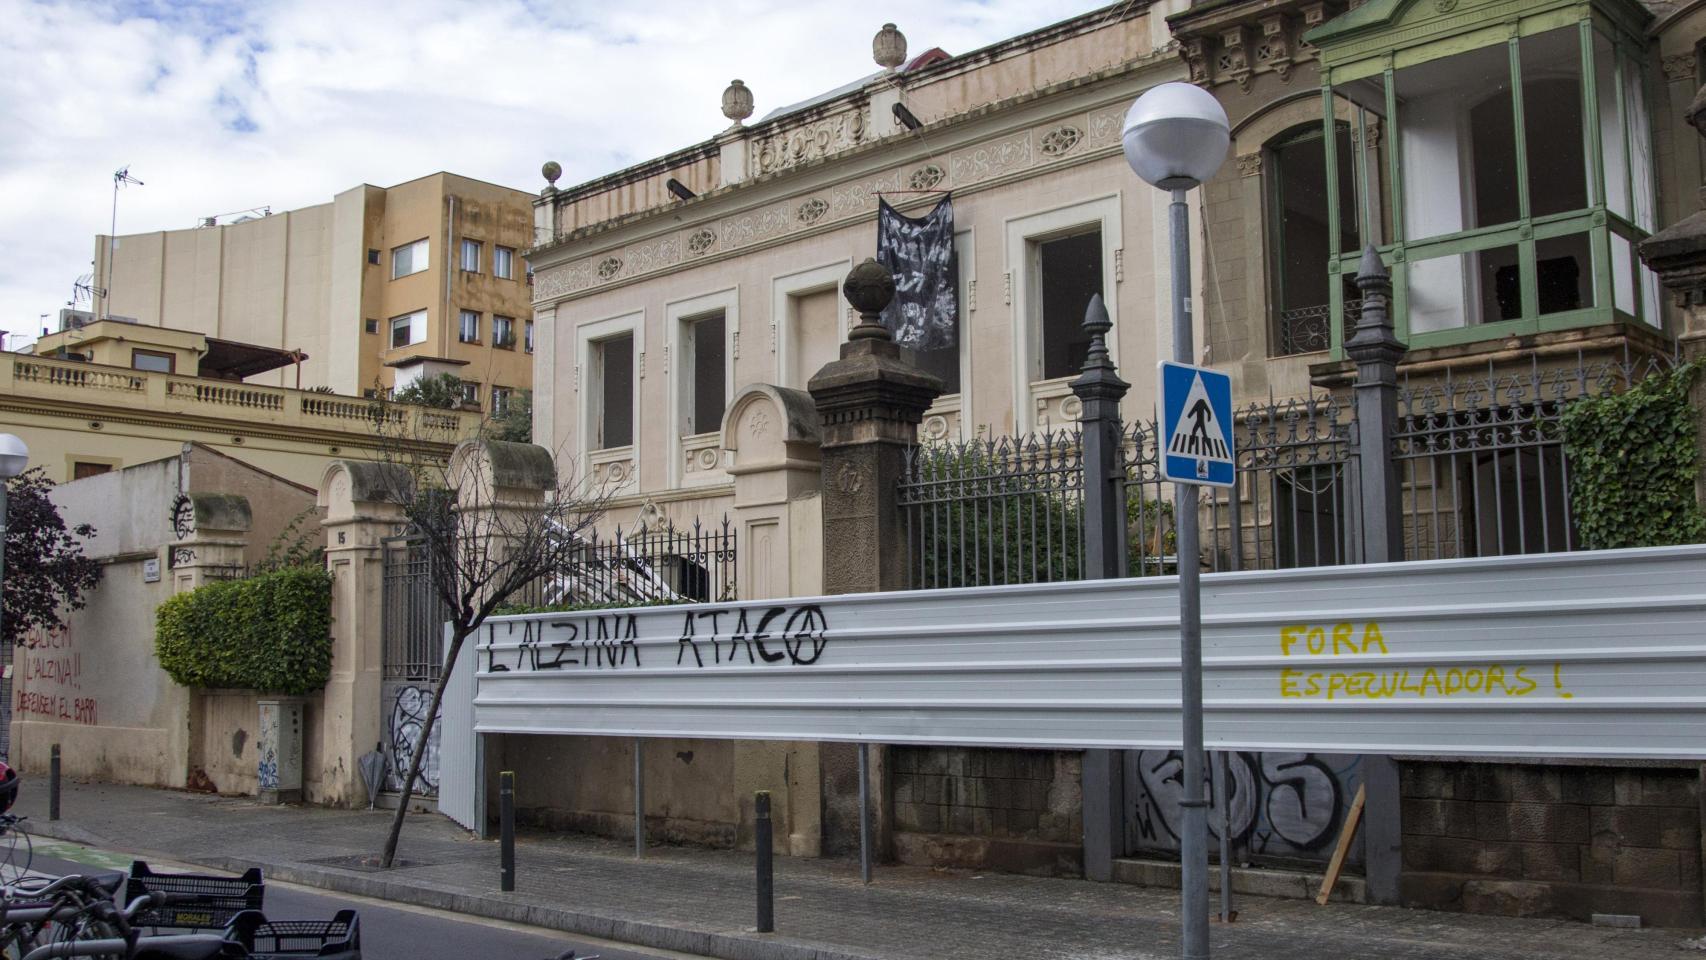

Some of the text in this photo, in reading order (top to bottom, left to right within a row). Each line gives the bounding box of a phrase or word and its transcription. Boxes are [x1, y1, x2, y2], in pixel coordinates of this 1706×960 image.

[338, 531, 346, 545] 15
[487, 612, 641, 673] L'ALZINA
[1279, 621, 1389, 656] FORA
[59, 697, 72, 719] EL
[74, 698, 98, 725] BARRI
